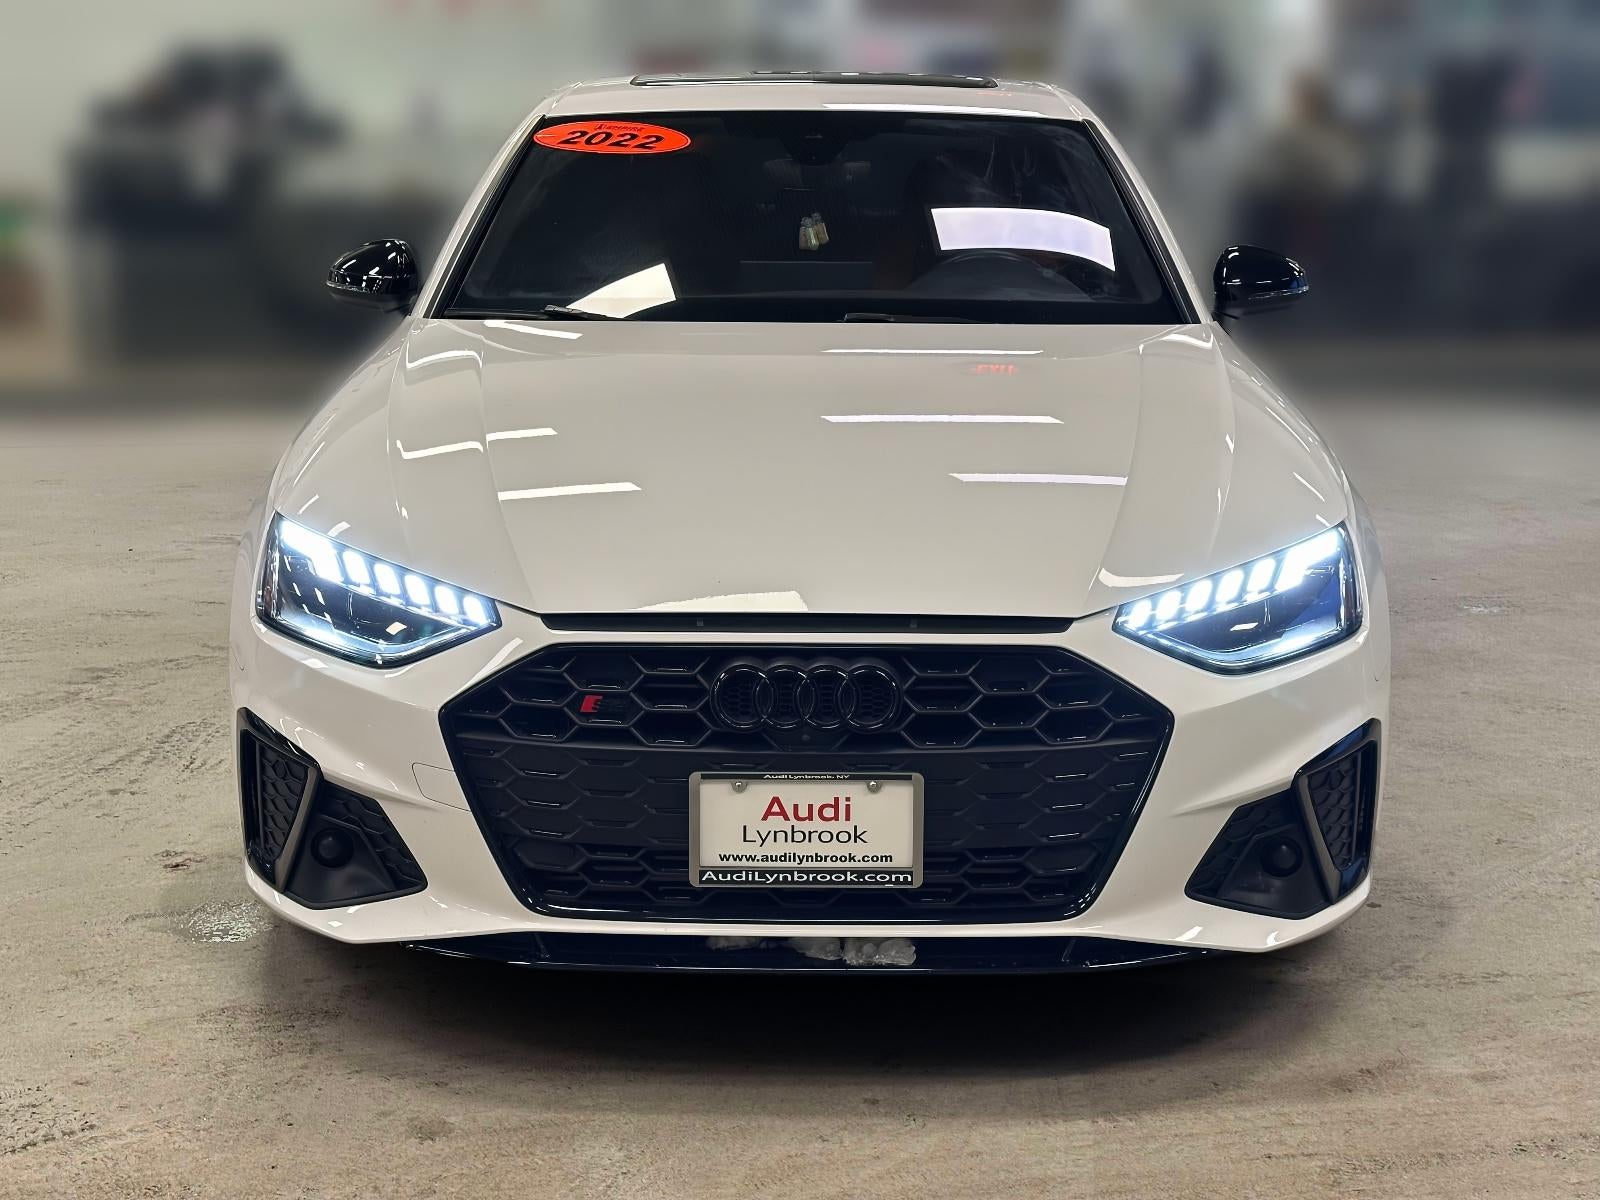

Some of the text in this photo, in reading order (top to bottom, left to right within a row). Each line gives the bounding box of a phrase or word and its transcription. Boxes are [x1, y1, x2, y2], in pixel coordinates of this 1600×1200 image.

[557, 130, 665, 149] 2022
[761, 796, 852, 822] Audi
[742, 825, 868, 847] Lynbrook
[718, 852, 893, 865] www.audilynbrook.com
[702, 870, 912, 884] AudiLynbrook.com
